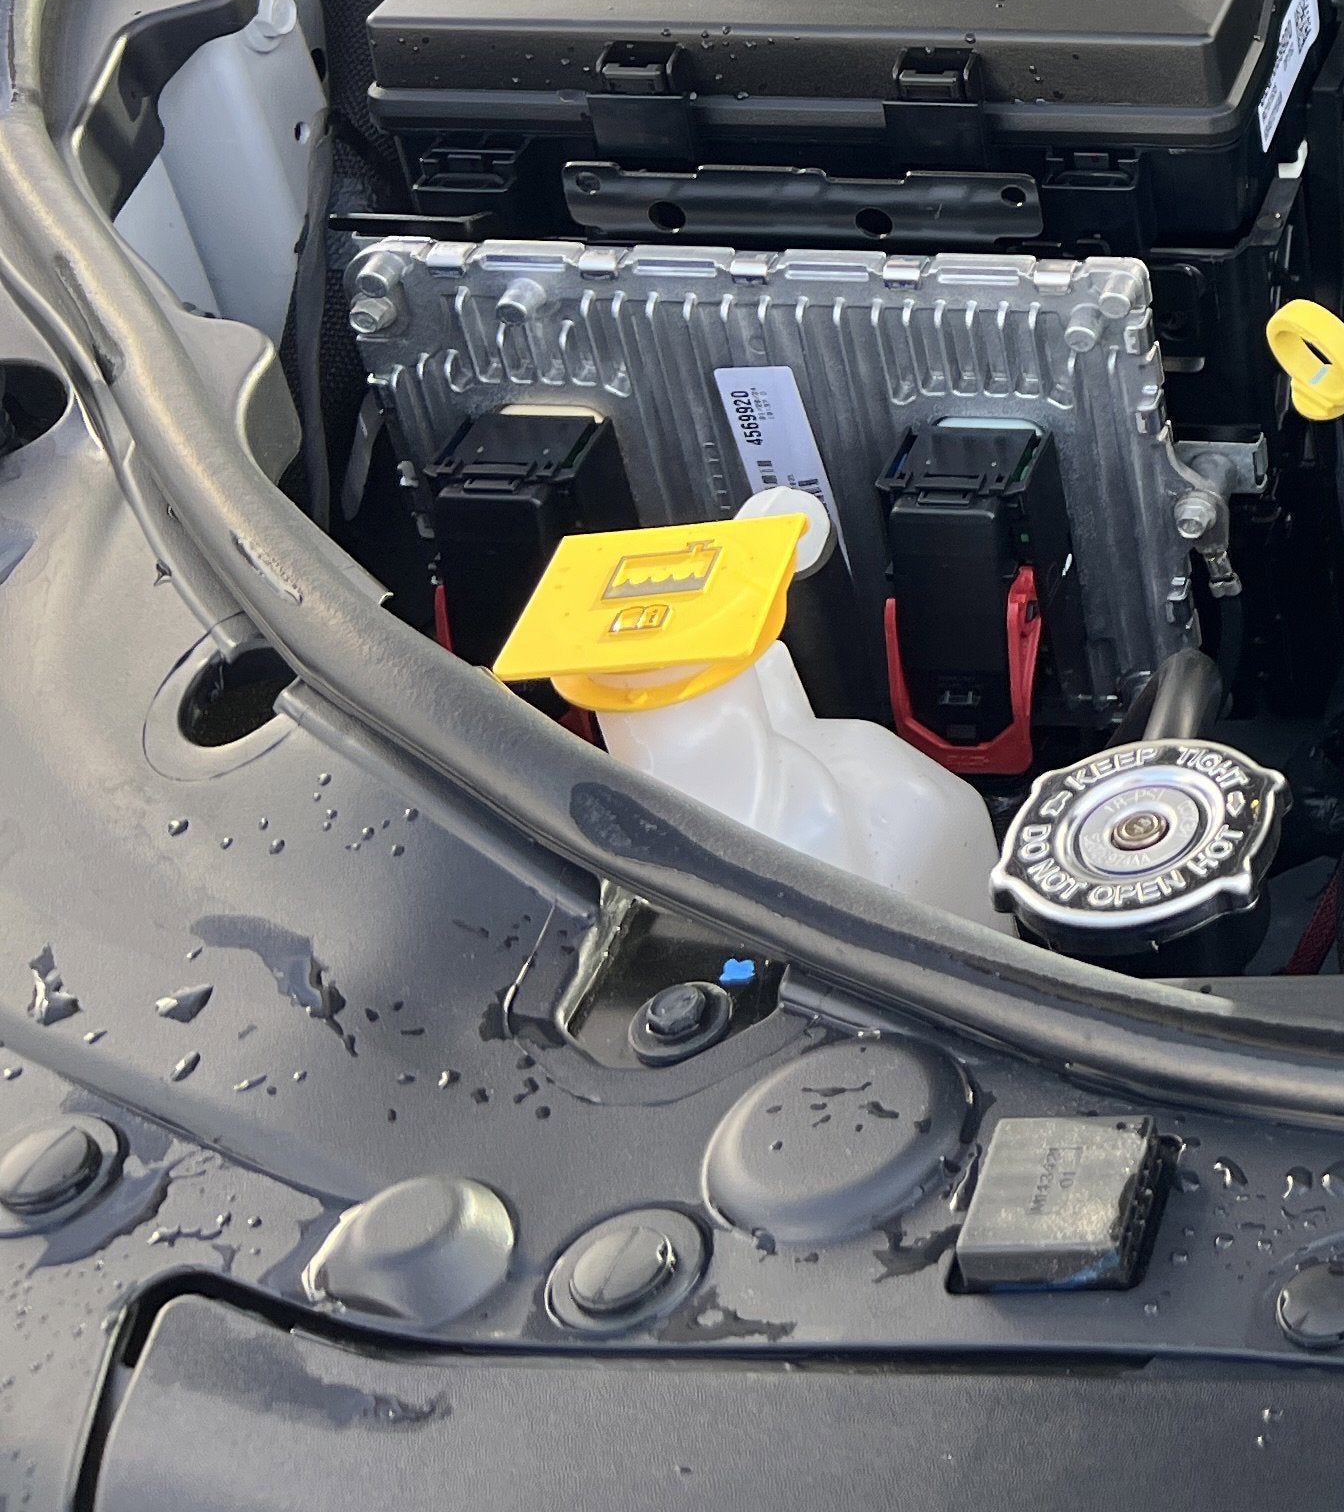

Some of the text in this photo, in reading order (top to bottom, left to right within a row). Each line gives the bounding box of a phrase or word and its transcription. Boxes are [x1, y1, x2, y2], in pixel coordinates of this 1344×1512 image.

[731, 390, 763, 445] 4569920
[1065, 746, 1249, 789] KEEP TIGHT
[1020, 823, 1051, 861] DO
[1186, 823, 1246, 877] HOT
[1027, 858, 1089, 901] NOT
[1087, 868, 1187, 906] OPEN
